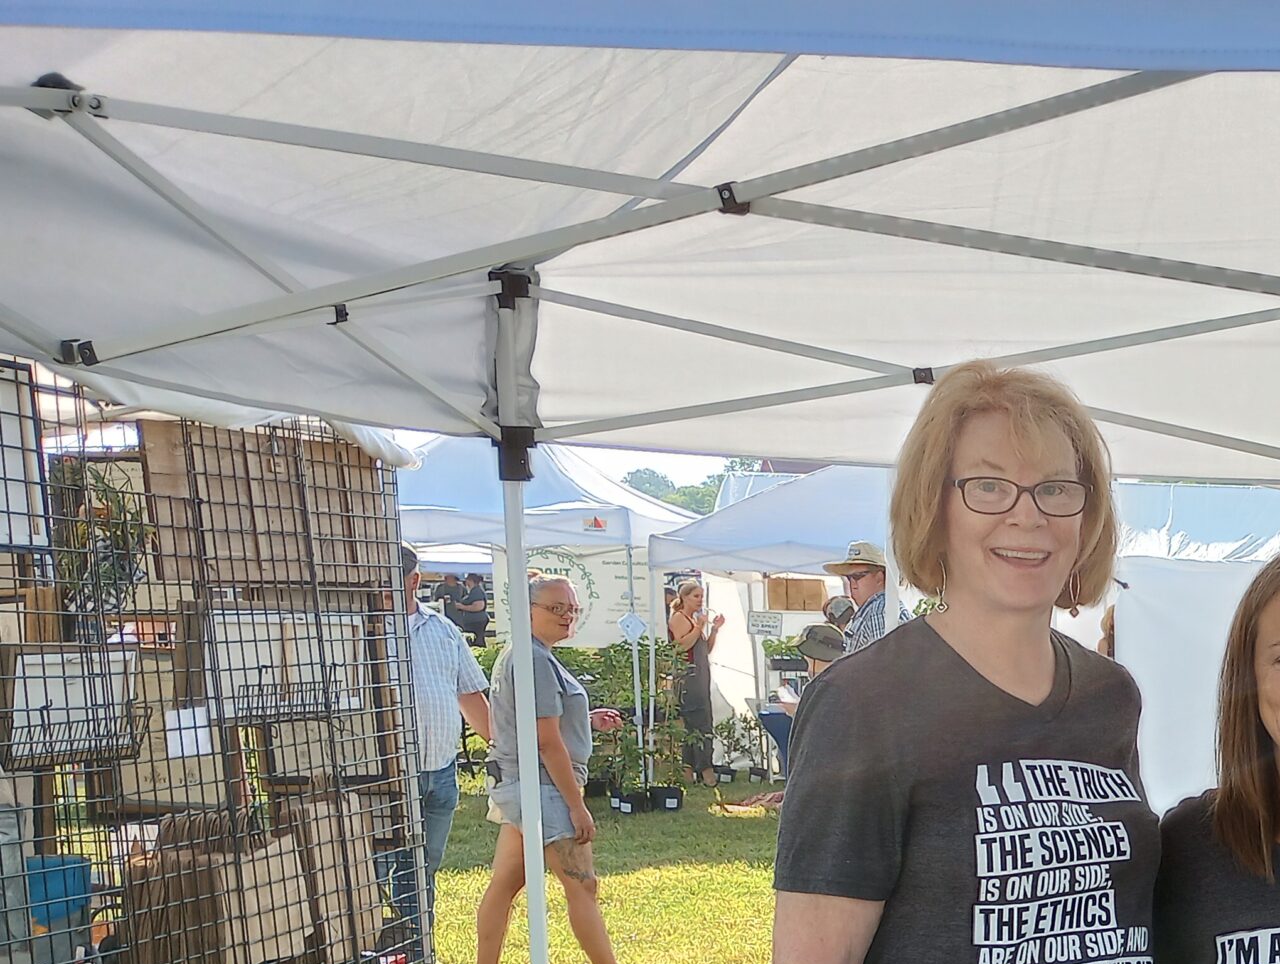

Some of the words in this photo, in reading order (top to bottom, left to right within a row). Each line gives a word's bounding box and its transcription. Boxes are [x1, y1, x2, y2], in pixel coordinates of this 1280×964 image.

[1026, 764, 1070, 798] THE
[1069, 766, 1136, 800] TRUTH
[976, 806, 998, 833] IS
[1000, 804, 1029, 829] ON
[1030, 802, 1060, 827] OUR
[1061, 803, 1104, 826] SIDE,
[980, 833, 1034, 873] THE
[1039, 824, 1128, 867] SCIENCE
[1074, 864, 1113, 893] SIDE,
[978, 905, 1030, 942] THE
[1034, 892, 1112, 935] ETHICS
[1085, 929, 1125, 958] SIDE,
[1126, 926, 1149, 952] AND
